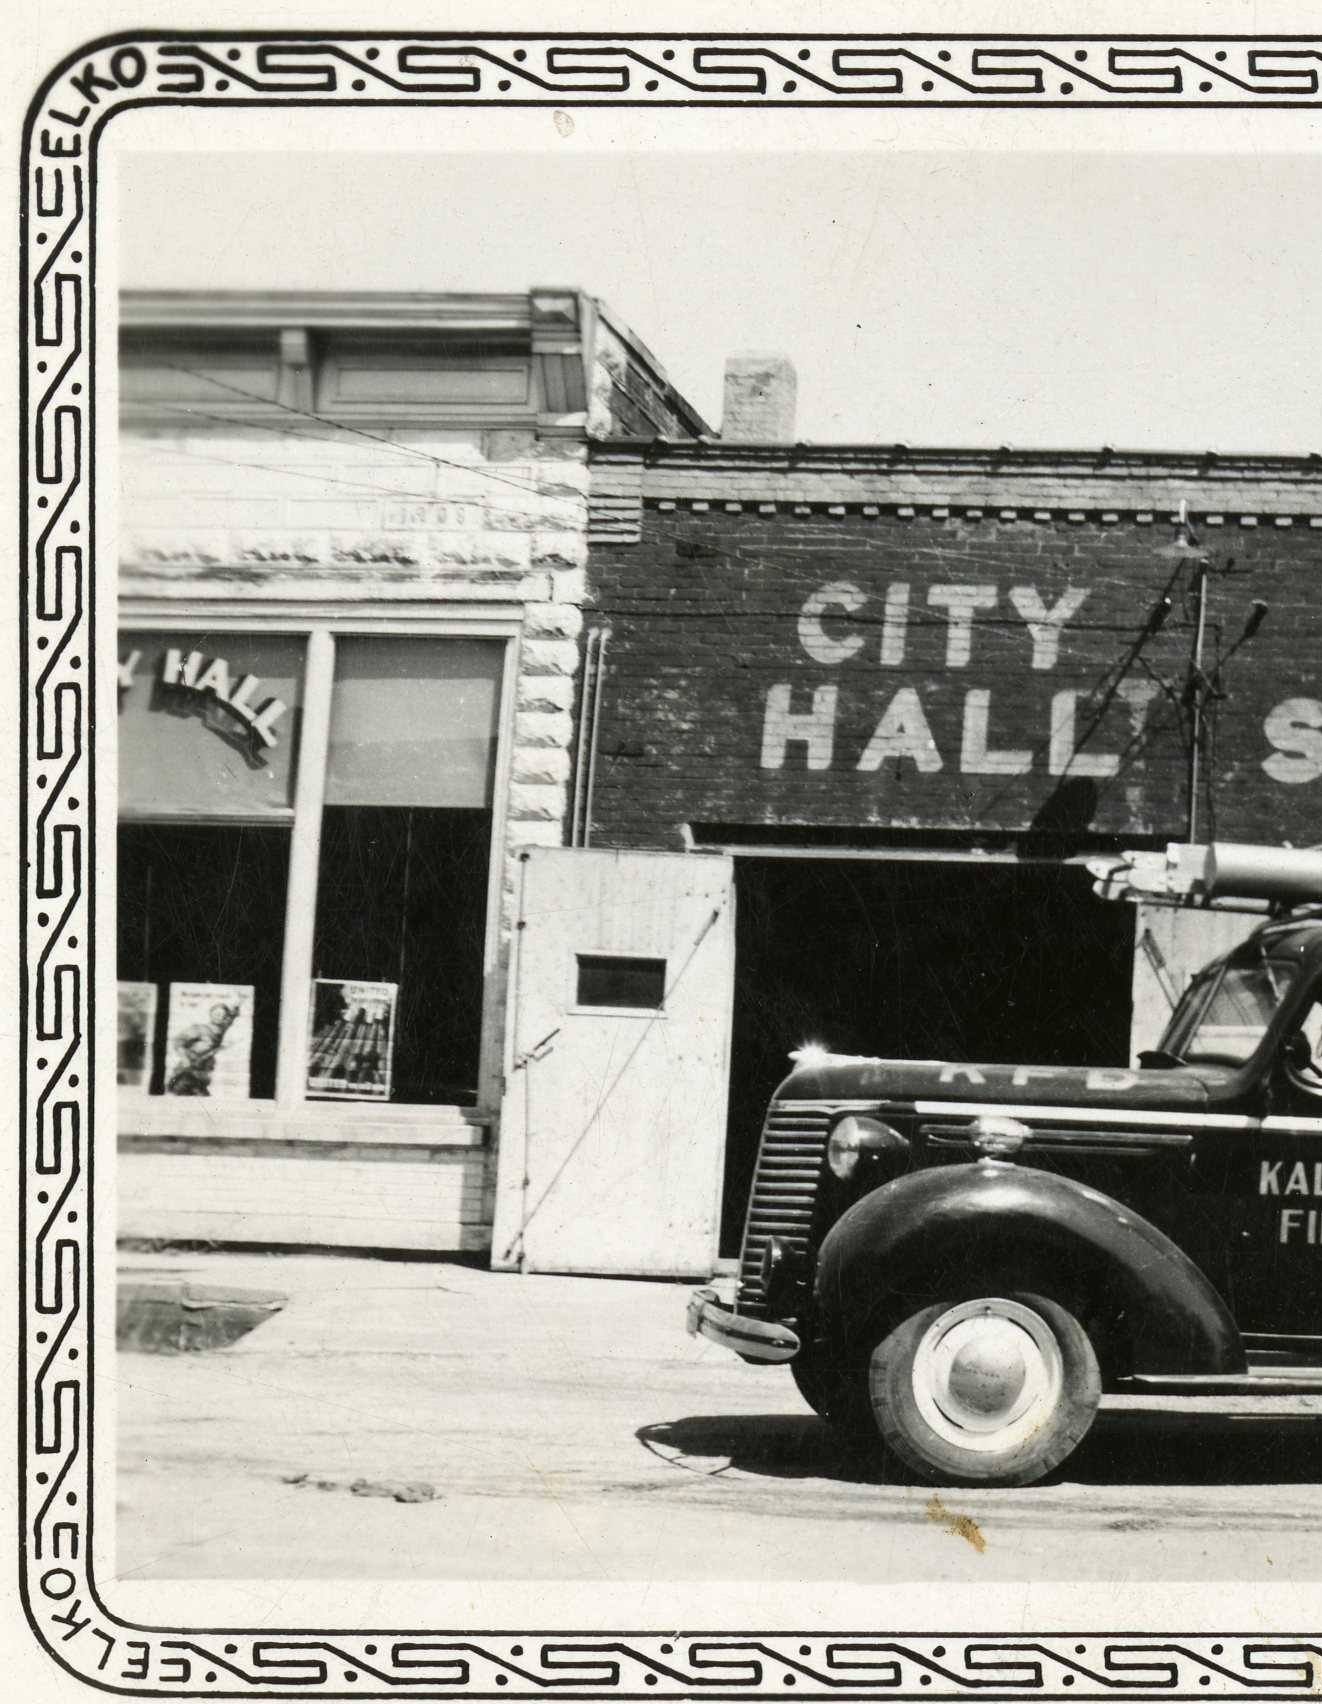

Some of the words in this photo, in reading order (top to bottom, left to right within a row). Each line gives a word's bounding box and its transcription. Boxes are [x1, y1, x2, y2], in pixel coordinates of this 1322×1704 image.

[40, 46, 147, 158] ELKO
[797, 580, 1092, 669] CITY
[162, 648, 288, 749] HALL
[759, 683, 1121, 777] HALL
[40, 1567, 151, 1680] ELKO
